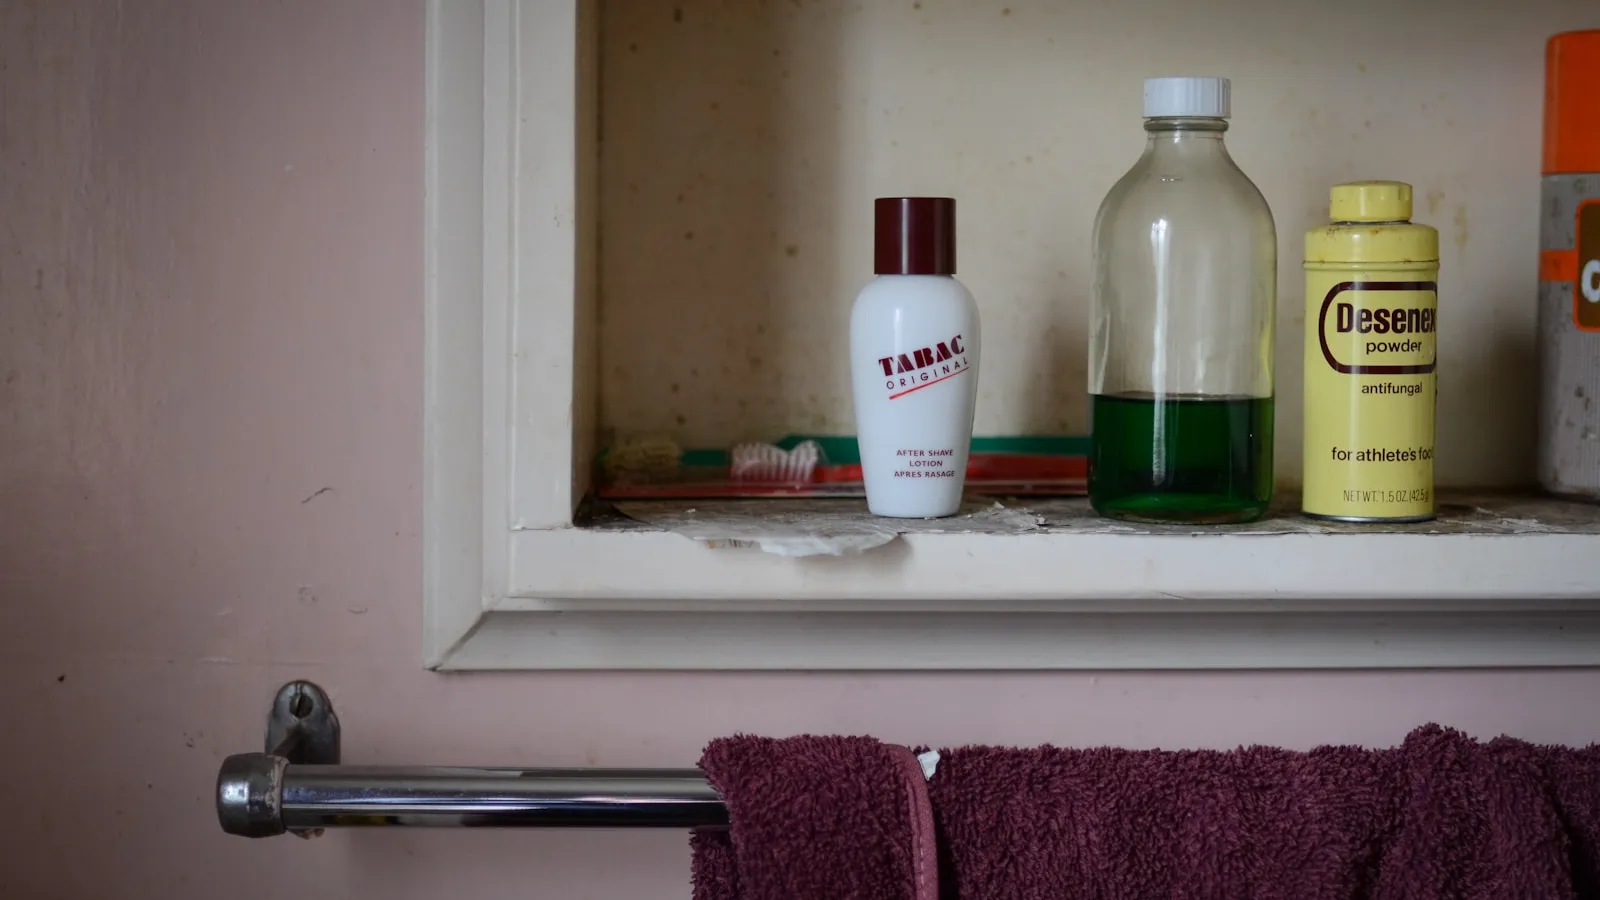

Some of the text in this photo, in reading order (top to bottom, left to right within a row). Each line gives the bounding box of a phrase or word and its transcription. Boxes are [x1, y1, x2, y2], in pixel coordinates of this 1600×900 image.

[1337, 303, 1436, 334] Desenex
[1366, 339, 1422, 355] powder
[878, 335, 965, 376] TABAC
[886, 357, 968, 390] ORIGINAL
[1361, 382, 1422, 396] antifungal
[896, 449, 954, 457] AFTER SHAVE
[1331, 447, 1353, 460] for
[1356, 447, 1417, 462] athlete's
[894, 470, 956, 478] APRES RASAGE
[1343, 489, 1360, 502] NET
[1380, 490, 1395, 503] 1.5
